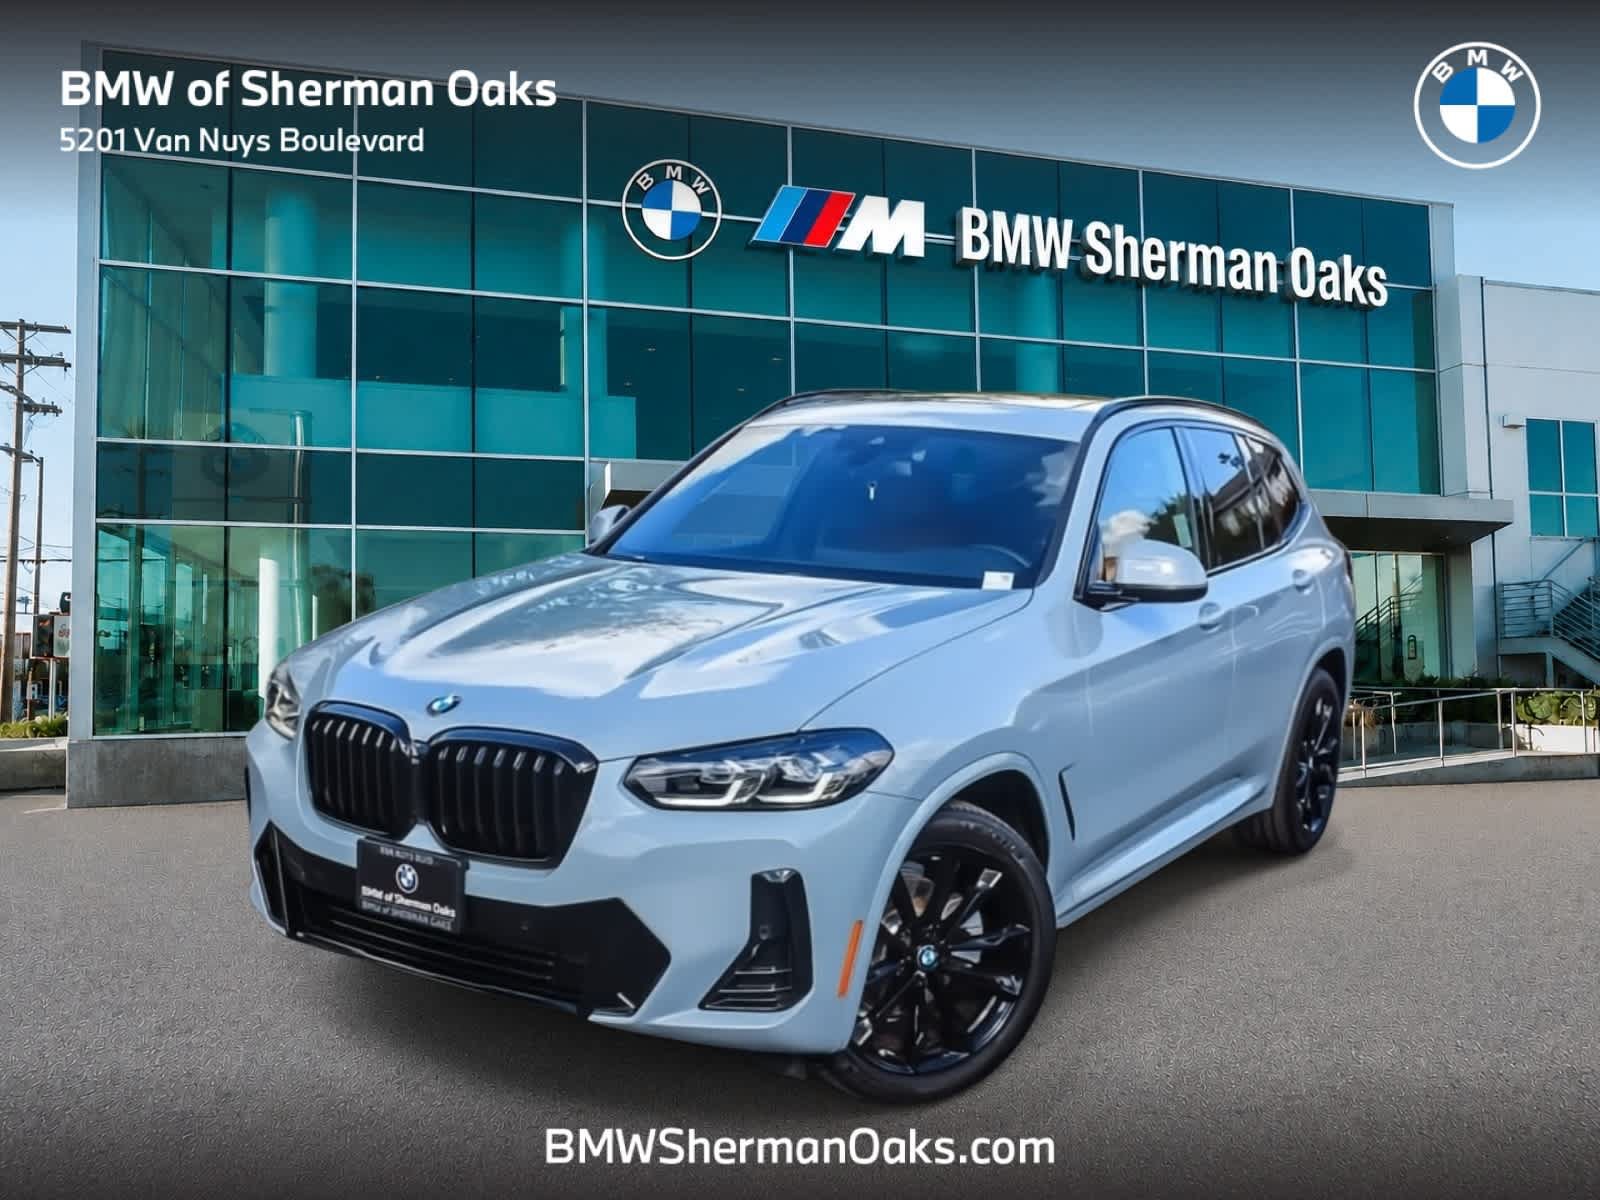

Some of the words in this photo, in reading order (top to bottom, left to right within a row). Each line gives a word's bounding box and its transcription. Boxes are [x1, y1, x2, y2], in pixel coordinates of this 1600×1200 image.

[636, 165, 710, 194] BMW
[835, 194, 925, 257] M
[958, 206, 1073, 270] BMW
[1083, 220, 1278, 293] Sherman
[1288, 246, 1389, 308] Oaks
[433, 903, 456, 918] Oaks
